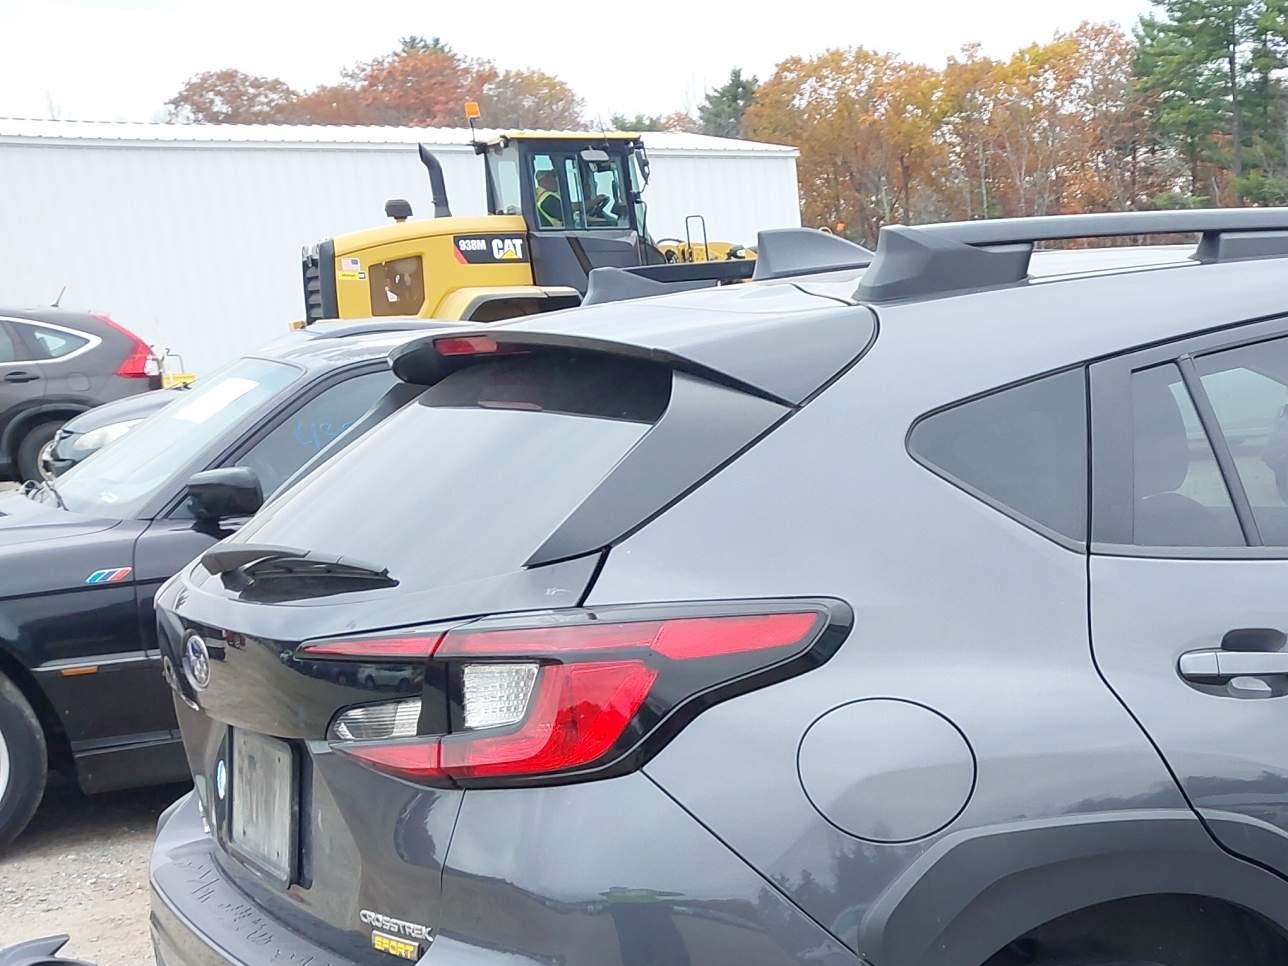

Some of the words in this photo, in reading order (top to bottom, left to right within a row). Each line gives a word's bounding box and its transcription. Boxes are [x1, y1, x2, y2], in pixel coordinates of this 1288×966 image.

[458, 239, 487, 251] 938M
[491, 238, 523, 260] CAT
[359, 909, 434, 942] CROSSTREK
[373, 934, 415, 959] SPORT
